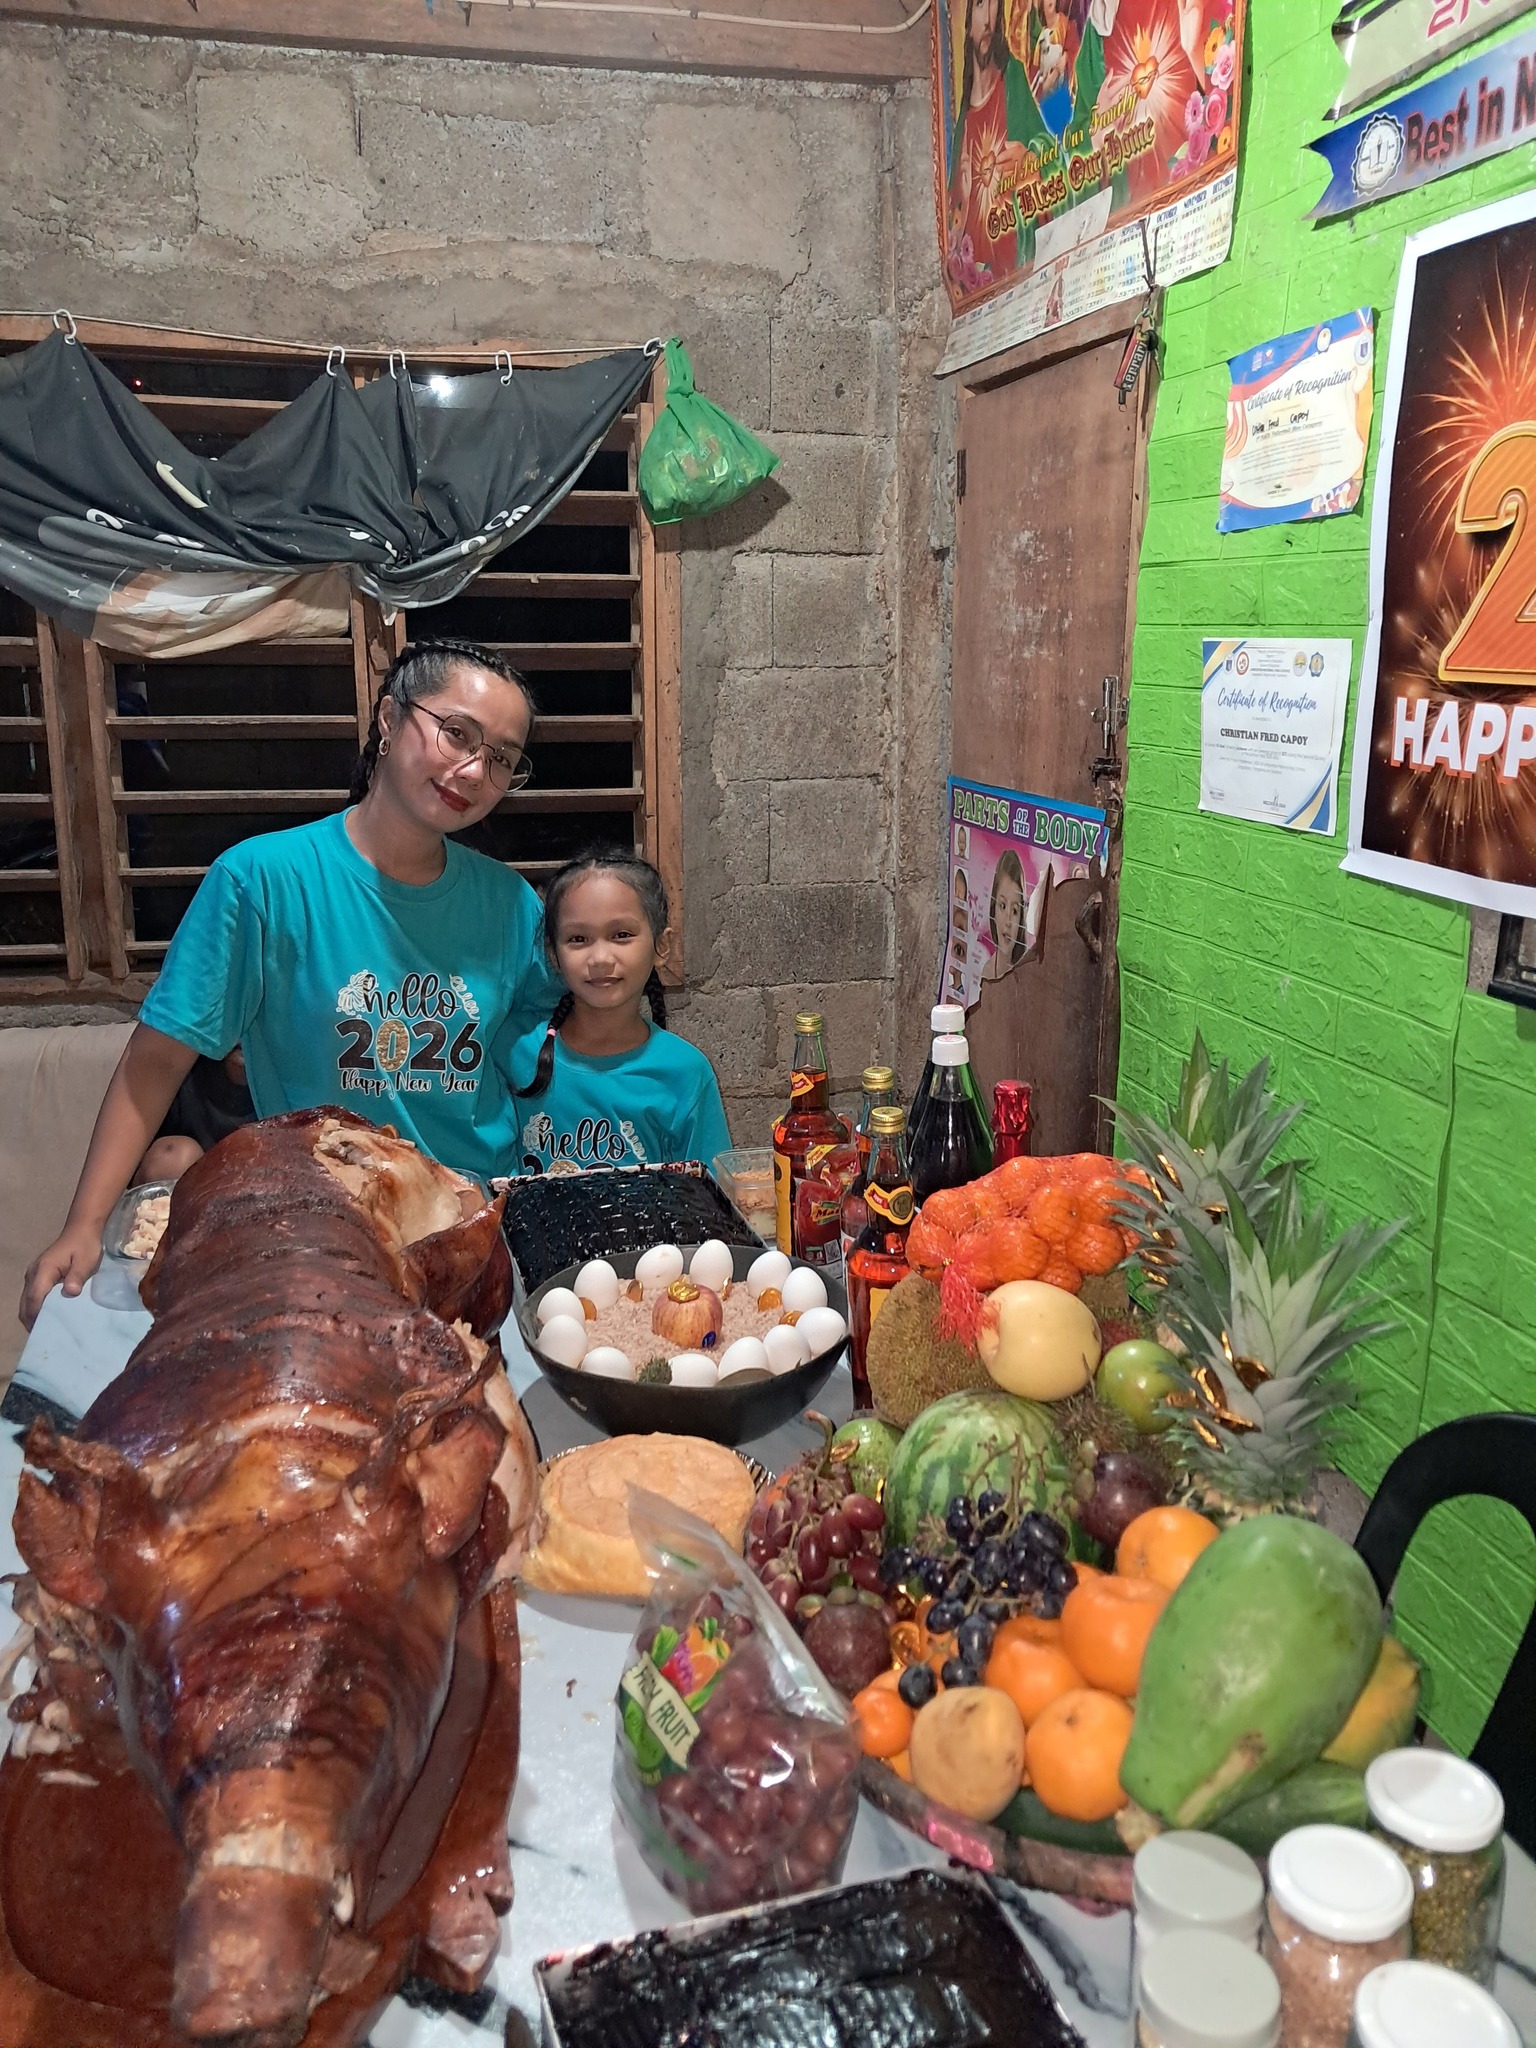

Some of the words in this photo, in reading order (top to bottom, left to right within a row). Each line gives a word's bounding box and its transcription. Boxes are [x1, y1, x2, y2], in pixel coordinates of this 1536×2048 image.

[1020, 134, 1059, 180] Protect
[1062, 124, 1084, 153] Our
[1089, 85, 1137, 137] Family
[1405, 87, 1469, 178] Best
[1474, 76, 1505, 149] in
[986, 202, 1018, 239] God
[1017, 170, 1067, 226] Bless
[1068, 150, 1103, 192] Our
[1103, 117, 1155, 175] Home
[1156, 206, 1177, 223] OCTOBER
[1247, 387, 1282, 412] Certificate
[1284, 381, 1296, 400] of
[1295, 368, 1352, 396] Recognition
[1217, 687, 1257, 711] Certificate
[1258, 691, 1268, 713] of
[1269, 692, 1318, 718] Recognition
[1220, 728, 1259, 741] CHRISTIAN
[1260, 731, 1279, 743] FRED
[1280, 733, 1308, 746] CAPOY
[953, 789, 1010, 833] PARTS
[1016, 808, 1029, 823] OF
[1034, 811, 1100, 858] BODY
[1013, 822, 1030, 838] THE
[362, 973, 462, 1020] hello
[335, 1019, 484, 1073] 2026
[341, 1070, 397, 1100] Happy
[395, 1071, 432, 1092] New
[441, 1072, 480, 1094] Year
[537, 1116, 632, 1162] hello
[650, 1699, 691, 1747] FRUIT
